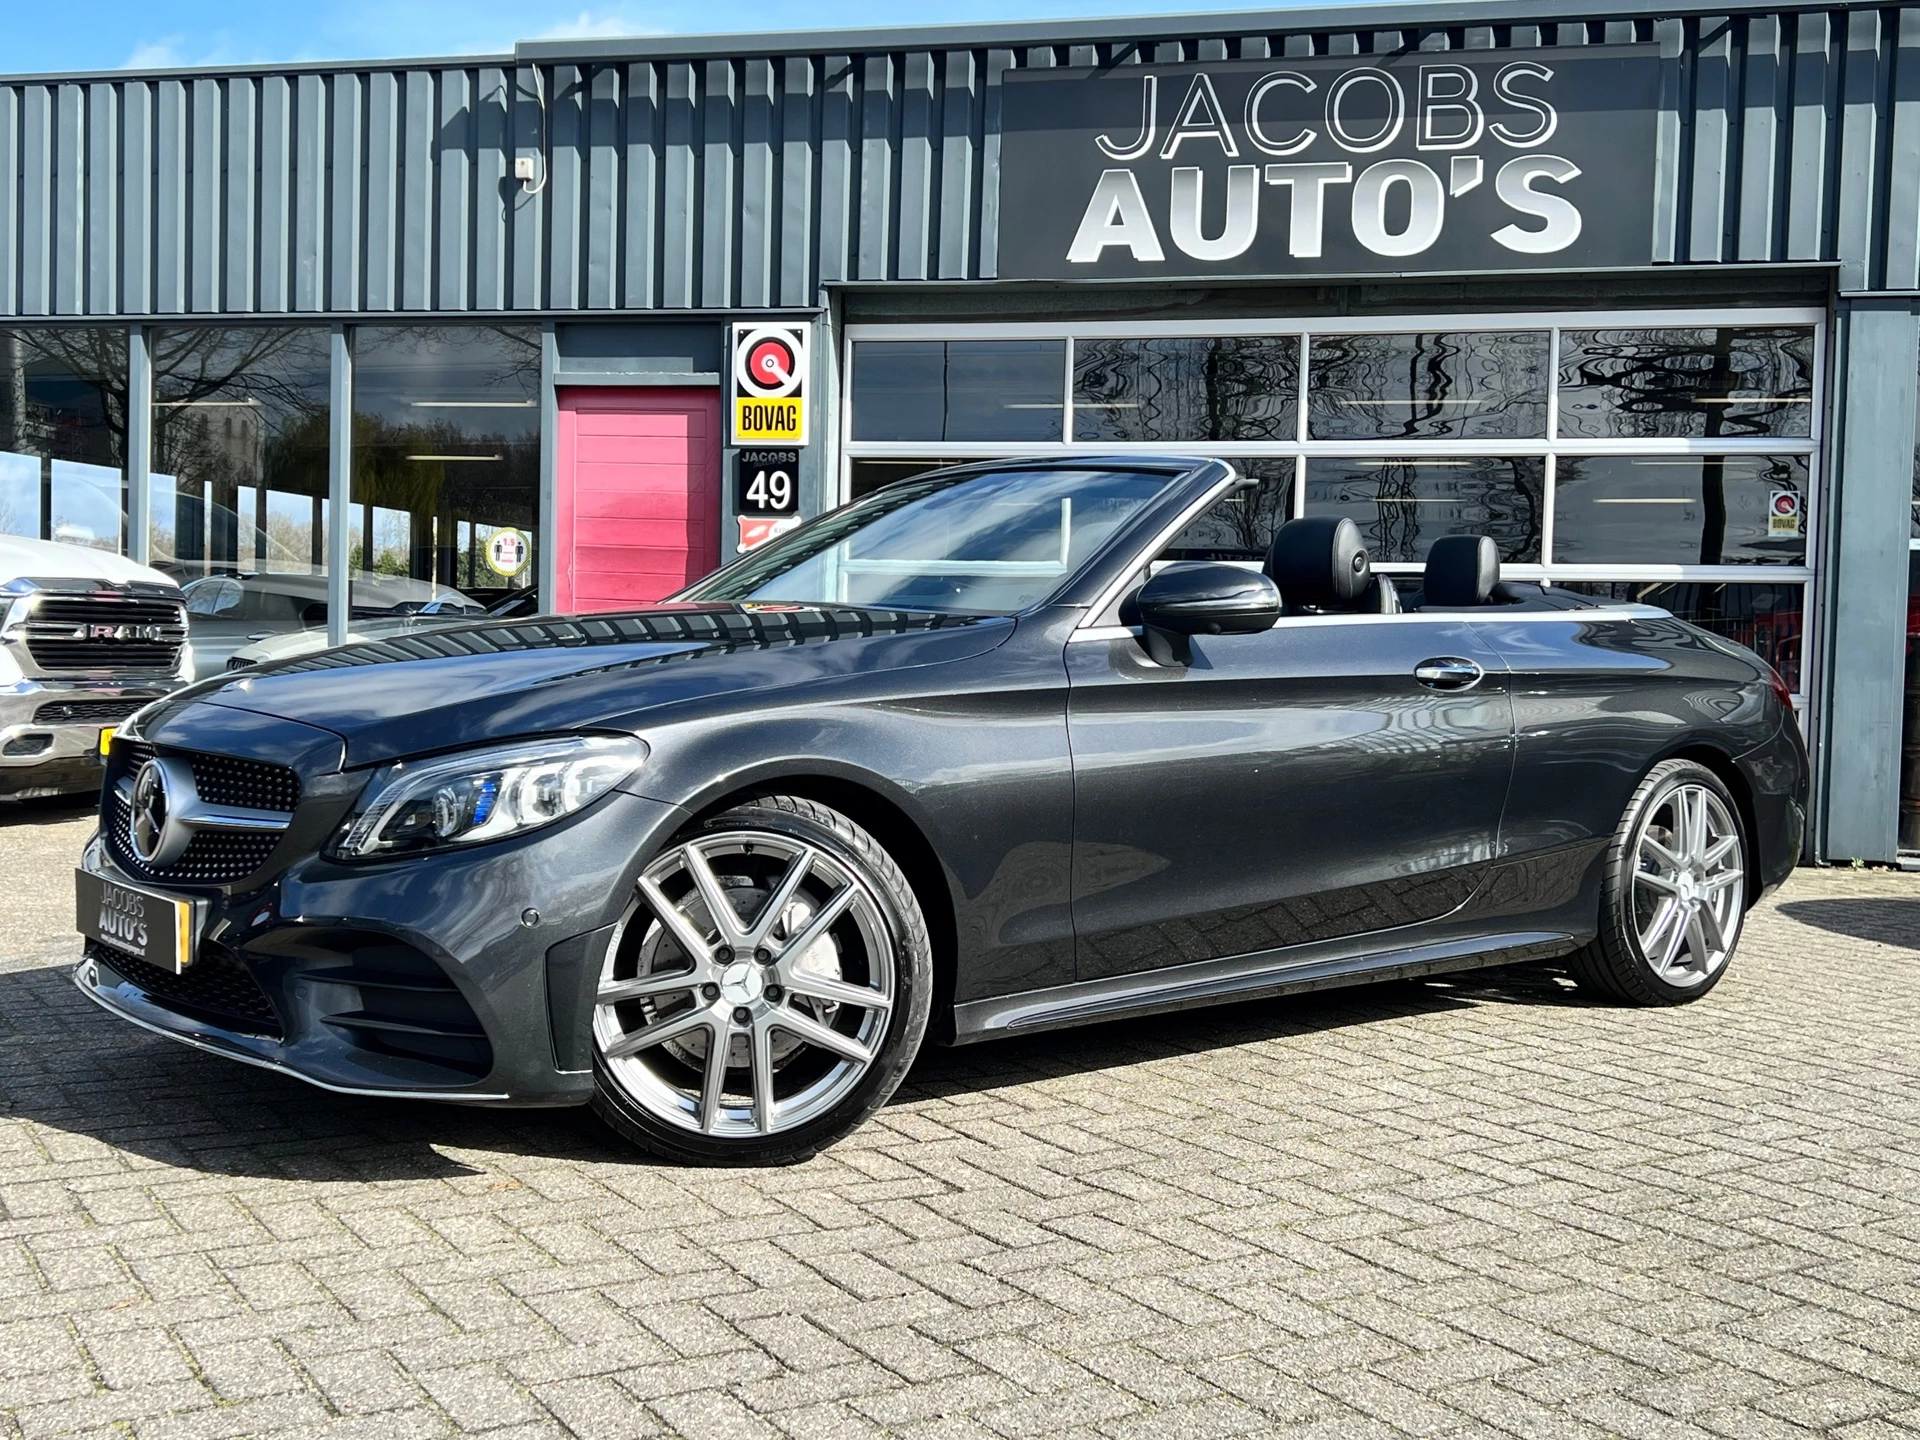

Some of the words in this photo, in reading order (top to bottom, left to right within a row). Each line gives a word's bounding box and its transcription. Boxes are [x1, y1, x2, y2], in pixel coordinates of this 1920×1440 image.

[1094, 61, 1559, 161] JACOBS
[1066, 153, 1584, 264] AUTO'S
[742, 405, 796, 431] BOVAG
[741, 451, 797, 463] JACOBS
[746, 470, 791, 510] 49
[1772, 518, 1795, 529] BOVAG
[89, 624, 161, 641] RAM
[100, 881, 145, 918] JACOBS
[98, 905, 148, 946] AUTO'S
